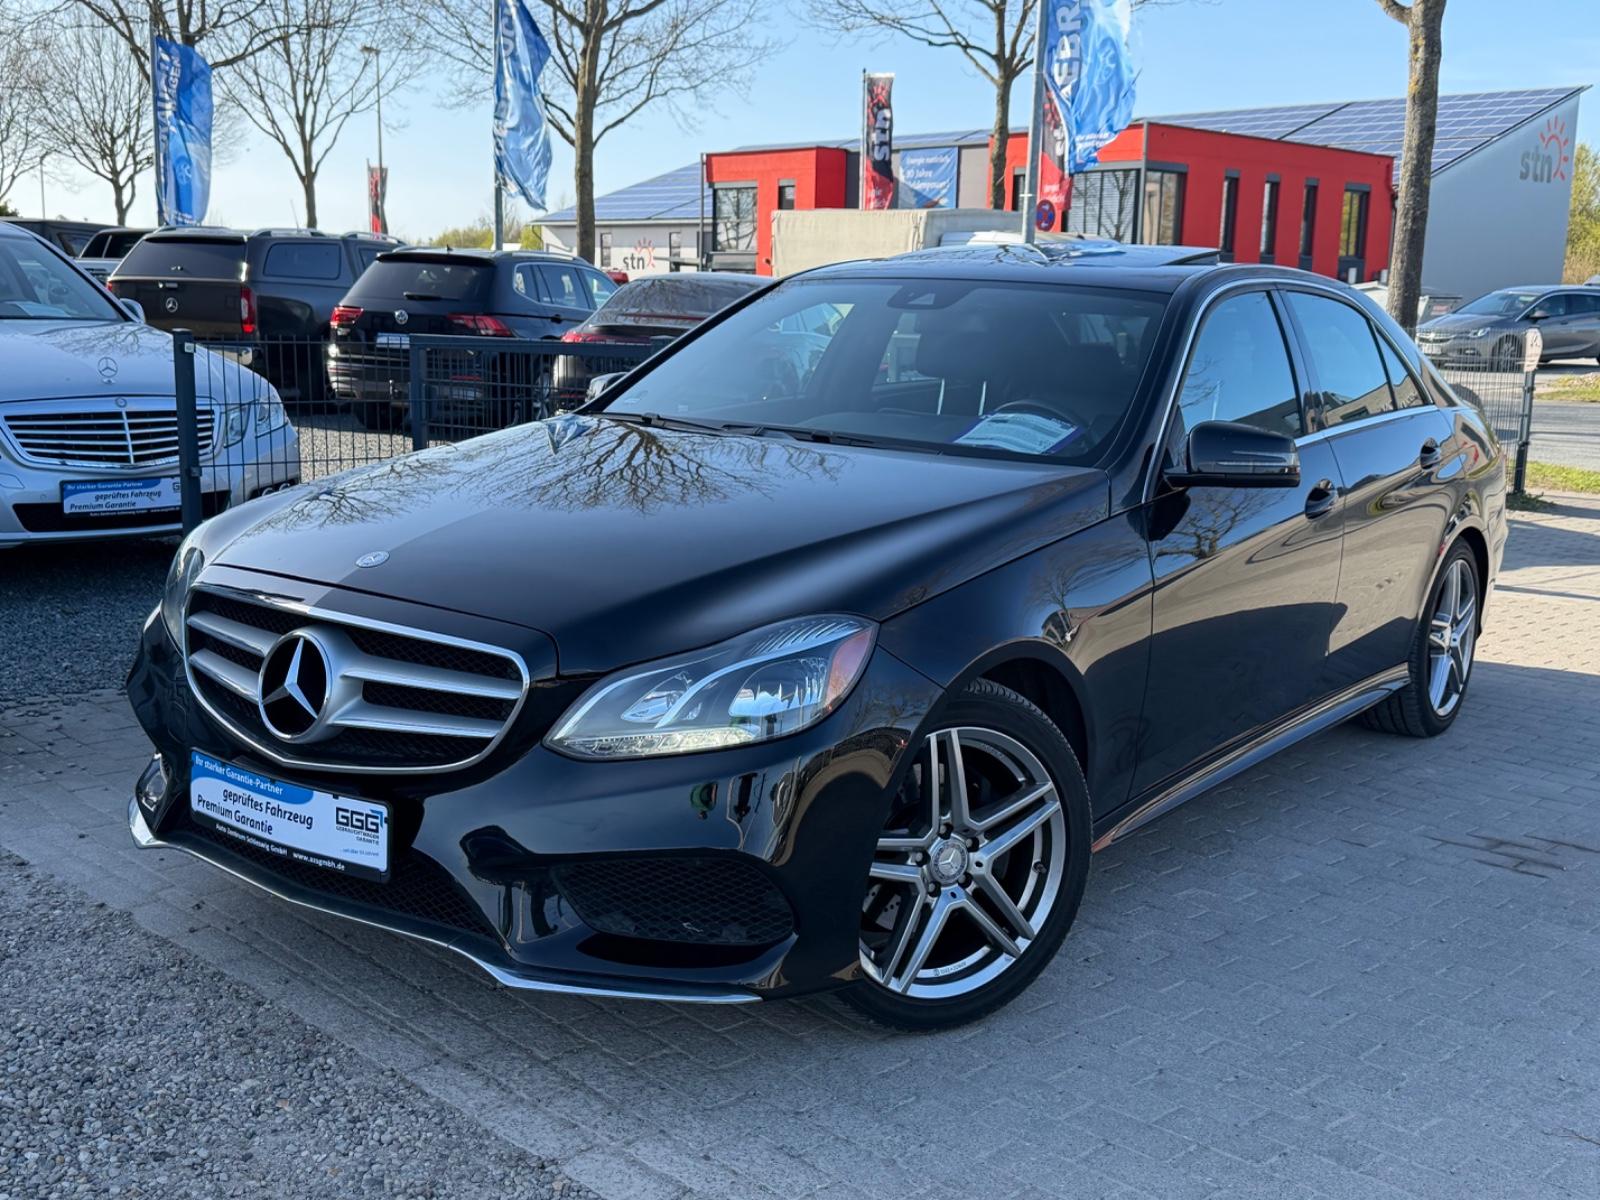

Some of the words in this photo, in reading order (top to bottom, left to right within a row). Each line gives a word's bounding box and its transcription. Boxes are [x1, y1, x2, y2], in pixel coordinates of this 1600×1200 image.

[873, 107, 892, 162] stn
[1519, 146, 1553, 183] stn
[623, 253, 645, 270] stn
[95, 491, 129, 502] geprüftes
[131, 489, 162, 498] Fahrzeug
[105, 500, 136, 509] Garantie
[195, 755, 203, 766] Ihr
[204, 760, 226, 775] starker
[226, 768, 283, 795] Garantie-Partner
[197, 794, 233, 820] Premium
[234, 810, 273, 835] Garantie
[223, 789, 263, 812] geprüftes
[265, 801, 314, 830] Fahrzeug
[335, 806, 380, 834] GGG
